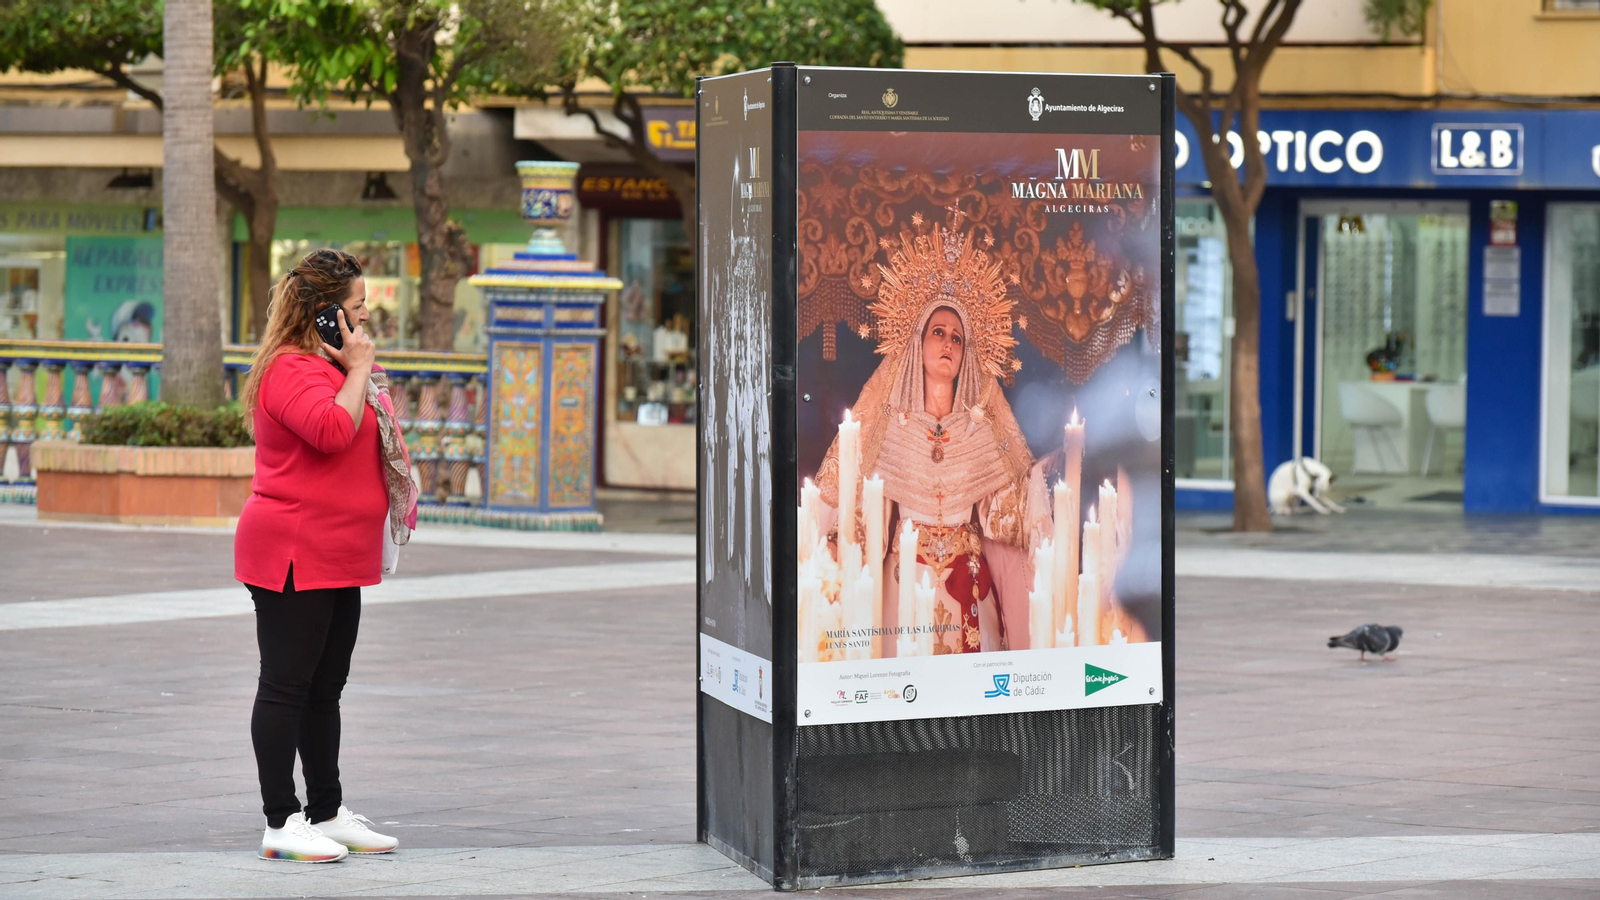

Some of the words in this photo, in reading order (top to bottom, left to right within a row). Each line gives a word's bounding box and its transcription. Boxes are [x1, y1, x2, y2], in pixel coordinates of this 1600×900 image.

[1045, 103, 1087, 112] Ayuntamiento
[1088, 104, 1096, 112] de
[1097, 104, 1124, 114] Algeciras
[1440, 129, 1514, 168] L&B
[1055, 148, 1100, 180] MM
[582, 176, 669, 191] ESTANC
[1011, 182, 1068, 199] MAGNA
[1072, 183, 1143, 199] MARIANA
[1044, 204, 1109, 213] ALGECIRAS
[16, 210, 60, 228] PARA
[826, 627, 850, 639] MARÍA
[851, 626, 893, 638] SANTÍSIMA
[894, 626, 906, 635] DE
[907, 625, 921, 634] LAS
[922, 622, 961, 634] LÁGRIMAS
[825, 641, 848, 650] LUNES
[848, 640, 870, 648] SANTO
[1013, 671, 1052, 684] Diputación
[854, 693, 869, 701] FAF
[1013, 687, 1022, 696] de
[1025, 685, 1045, 696] Cádiz
